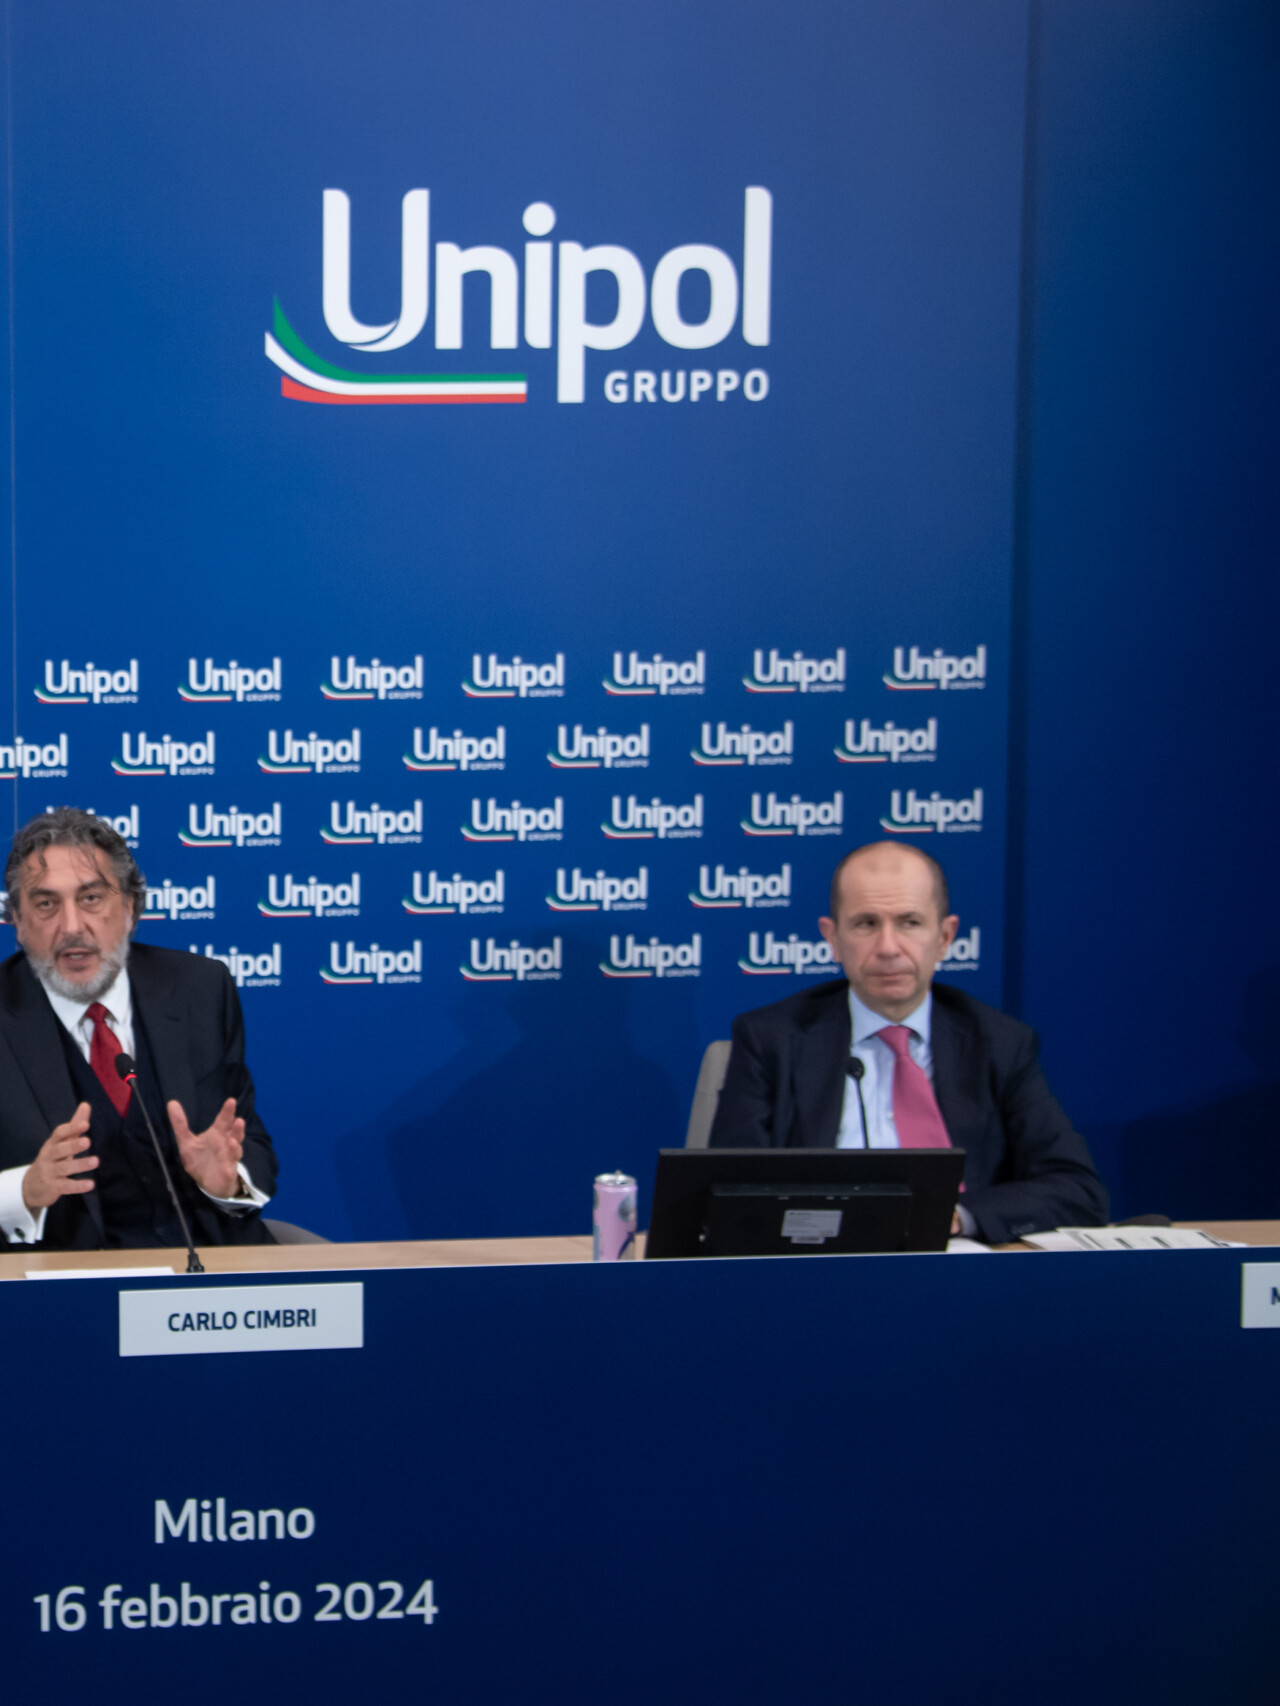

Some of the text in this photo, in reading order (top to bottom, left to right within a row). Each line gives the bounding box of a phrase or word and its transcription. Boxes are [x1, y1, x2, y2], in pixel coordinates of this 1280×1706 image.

[322, 185, 773, 403] Unipol
[604, 368, 770, 403] GRUPPO
[44, 658, 139, 704] Unipol
[188, 656, 282, 702] Unipol
[330, 654, 424, 700] Unipol
[471, 652, 565, 698] Unipol
[612, 650, 706, 696] Unipol
[752, 647, 846, 693] Unipol
[893, 644, 986, 691] Unipol
[121, 730, 215, 776] Unipol
[267, 728, 361, 774] Unipol
[412, 725, 506, 771] Unipol
[556, 723, 650, 769] Unipol
[700, 720, 794, 766] Unipol
[844, 717, 937, 763] Unipol
[188, 802, 281, 847] Unipol
[330, 799, 423, 845] Unipol
[470, 796, 563, 842] Unipol
[611, 794, 704, 839] Unipol
[750, 791, 843, 836] Unipol
[890, 788, 983, 833] Unipol
[143, 875, 215, 921] nipol
[267, 872, 360, 918] Unipol
[412, 869, 505, 915] Unipol
[555, 866, 648, 912] Unipol
[699, 863, 791, 908] Unipol
[188, 943, 281, 988] ipol
[329, 939, 422, 984] Unipol
[470, 936, 562, 981] Unipol
[609, 933, 701, 978] Unipol
[748, 931, 834, 975] Unipo
[167, 1308, 317, 1333] CARLO CIMBRI
[154, 1498, 316, 1544] Milano
[33, 1579, 439, 1633] 16 febbraio 2024
